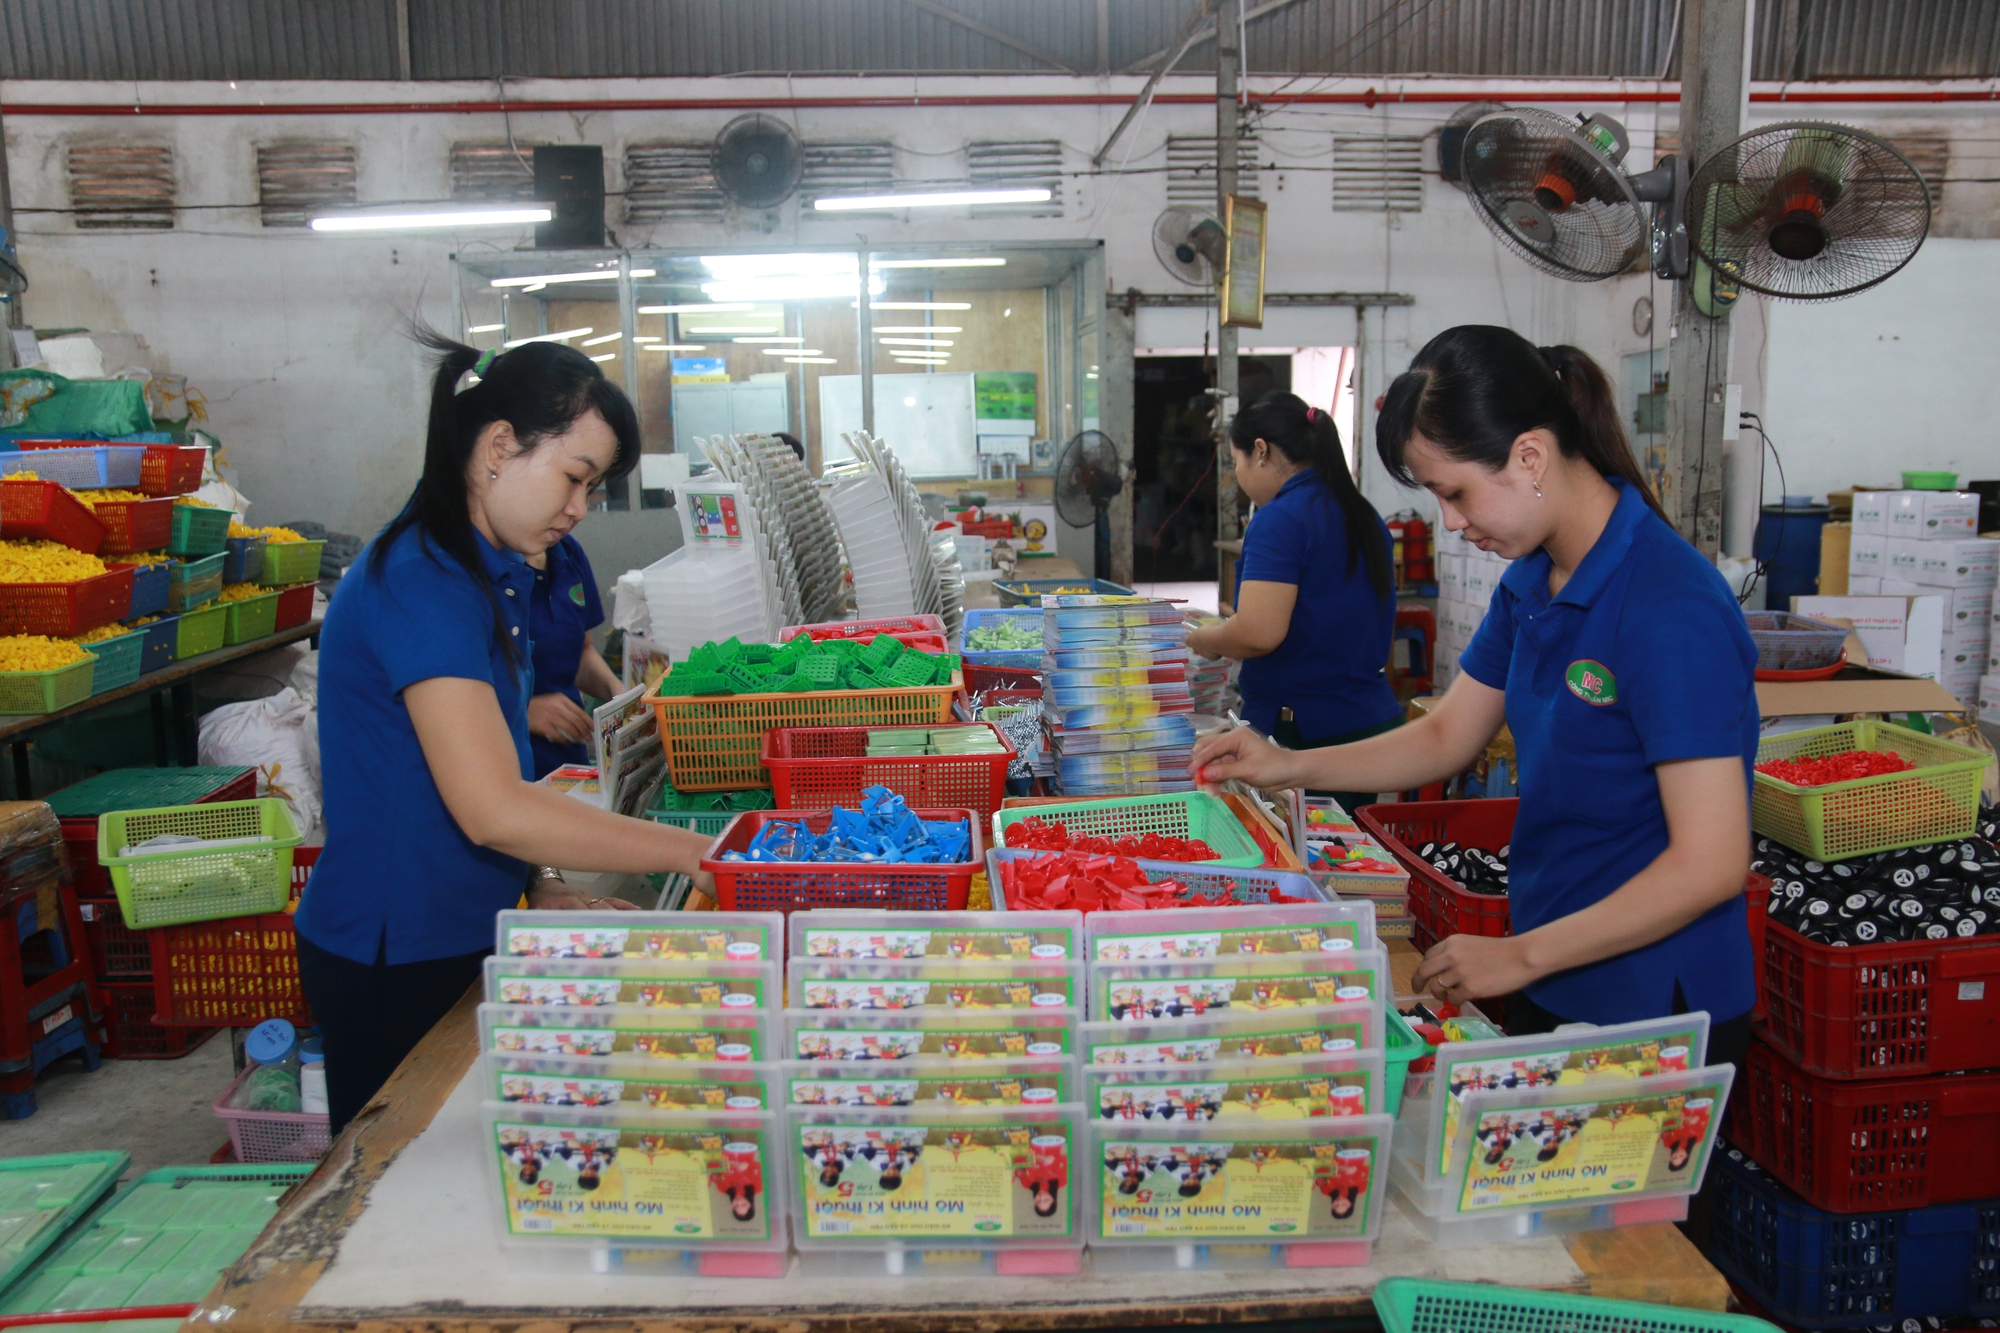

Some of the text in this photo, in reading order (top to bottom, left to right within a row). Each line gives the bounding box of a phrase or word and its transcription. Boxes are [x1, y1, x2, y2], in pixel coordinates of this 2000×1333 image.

[1497, 1157, 1515, 1173] 5
[1582, 1164, 1607, 1178] Mô
[1472, 1174, 1517, 1190] thuật
[1541, 1168, 1576, 1182] hình
[538, 1180, 554, 1195] 5
[838, 1181, 854, 1197] 5
[1136, 1189, 1154, 1203] 5
[517, 1197, 564, 1213] thuật
[591, 1200, 628, 1214] hình
[635, 1201, 663, 1215] Mô
[815, 1199, 863, 1215] thuật
[891, 1200, 928, 1214] hình
[935, 1200, 964, 1214] Mô
[1111, 1204, 1159, 1218] thuật
[1187, 1205, 1225, 1217] hình
[1232, 1205, 1261, 1217] Mô
